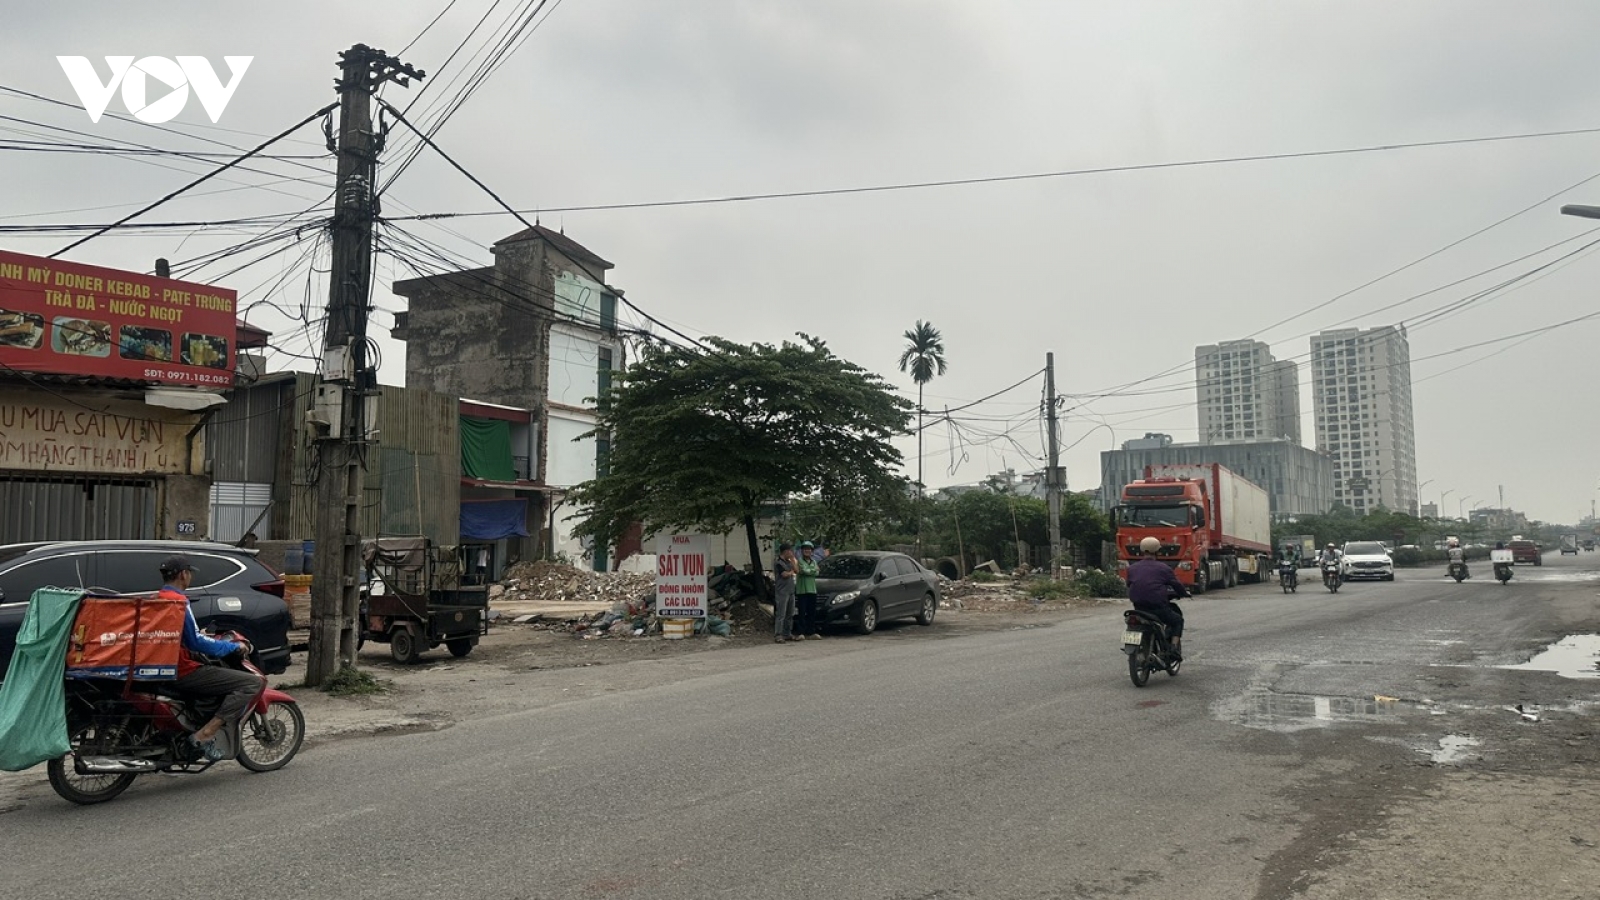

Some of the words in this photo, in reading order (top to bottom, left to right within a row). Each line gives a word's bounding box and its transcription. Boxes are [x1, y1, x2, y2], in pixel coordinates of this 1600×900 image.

[55, 271, 103, 292] DONER
[107, 280, 151, 299] KEBAB
[163, 289, 191, 306] PATE
[45, 289, 72, 308] TRÀ
[76, 293, 96, 311] ĐÁ
[109, 299, 146, 317] NƯỚC
[150, 305, 183, 324] NGỌT
[21, 406, 69, 434] MUA
[178, 523, 195, 532] 975
[672, 536, 690, 545] MUA
[659, 545, 679, 576] SẮT
[682, 554, 704, 581] VỤN
[664, 595, 680, 607] CÁC
[682, 597, 699, 609] LOẠI
